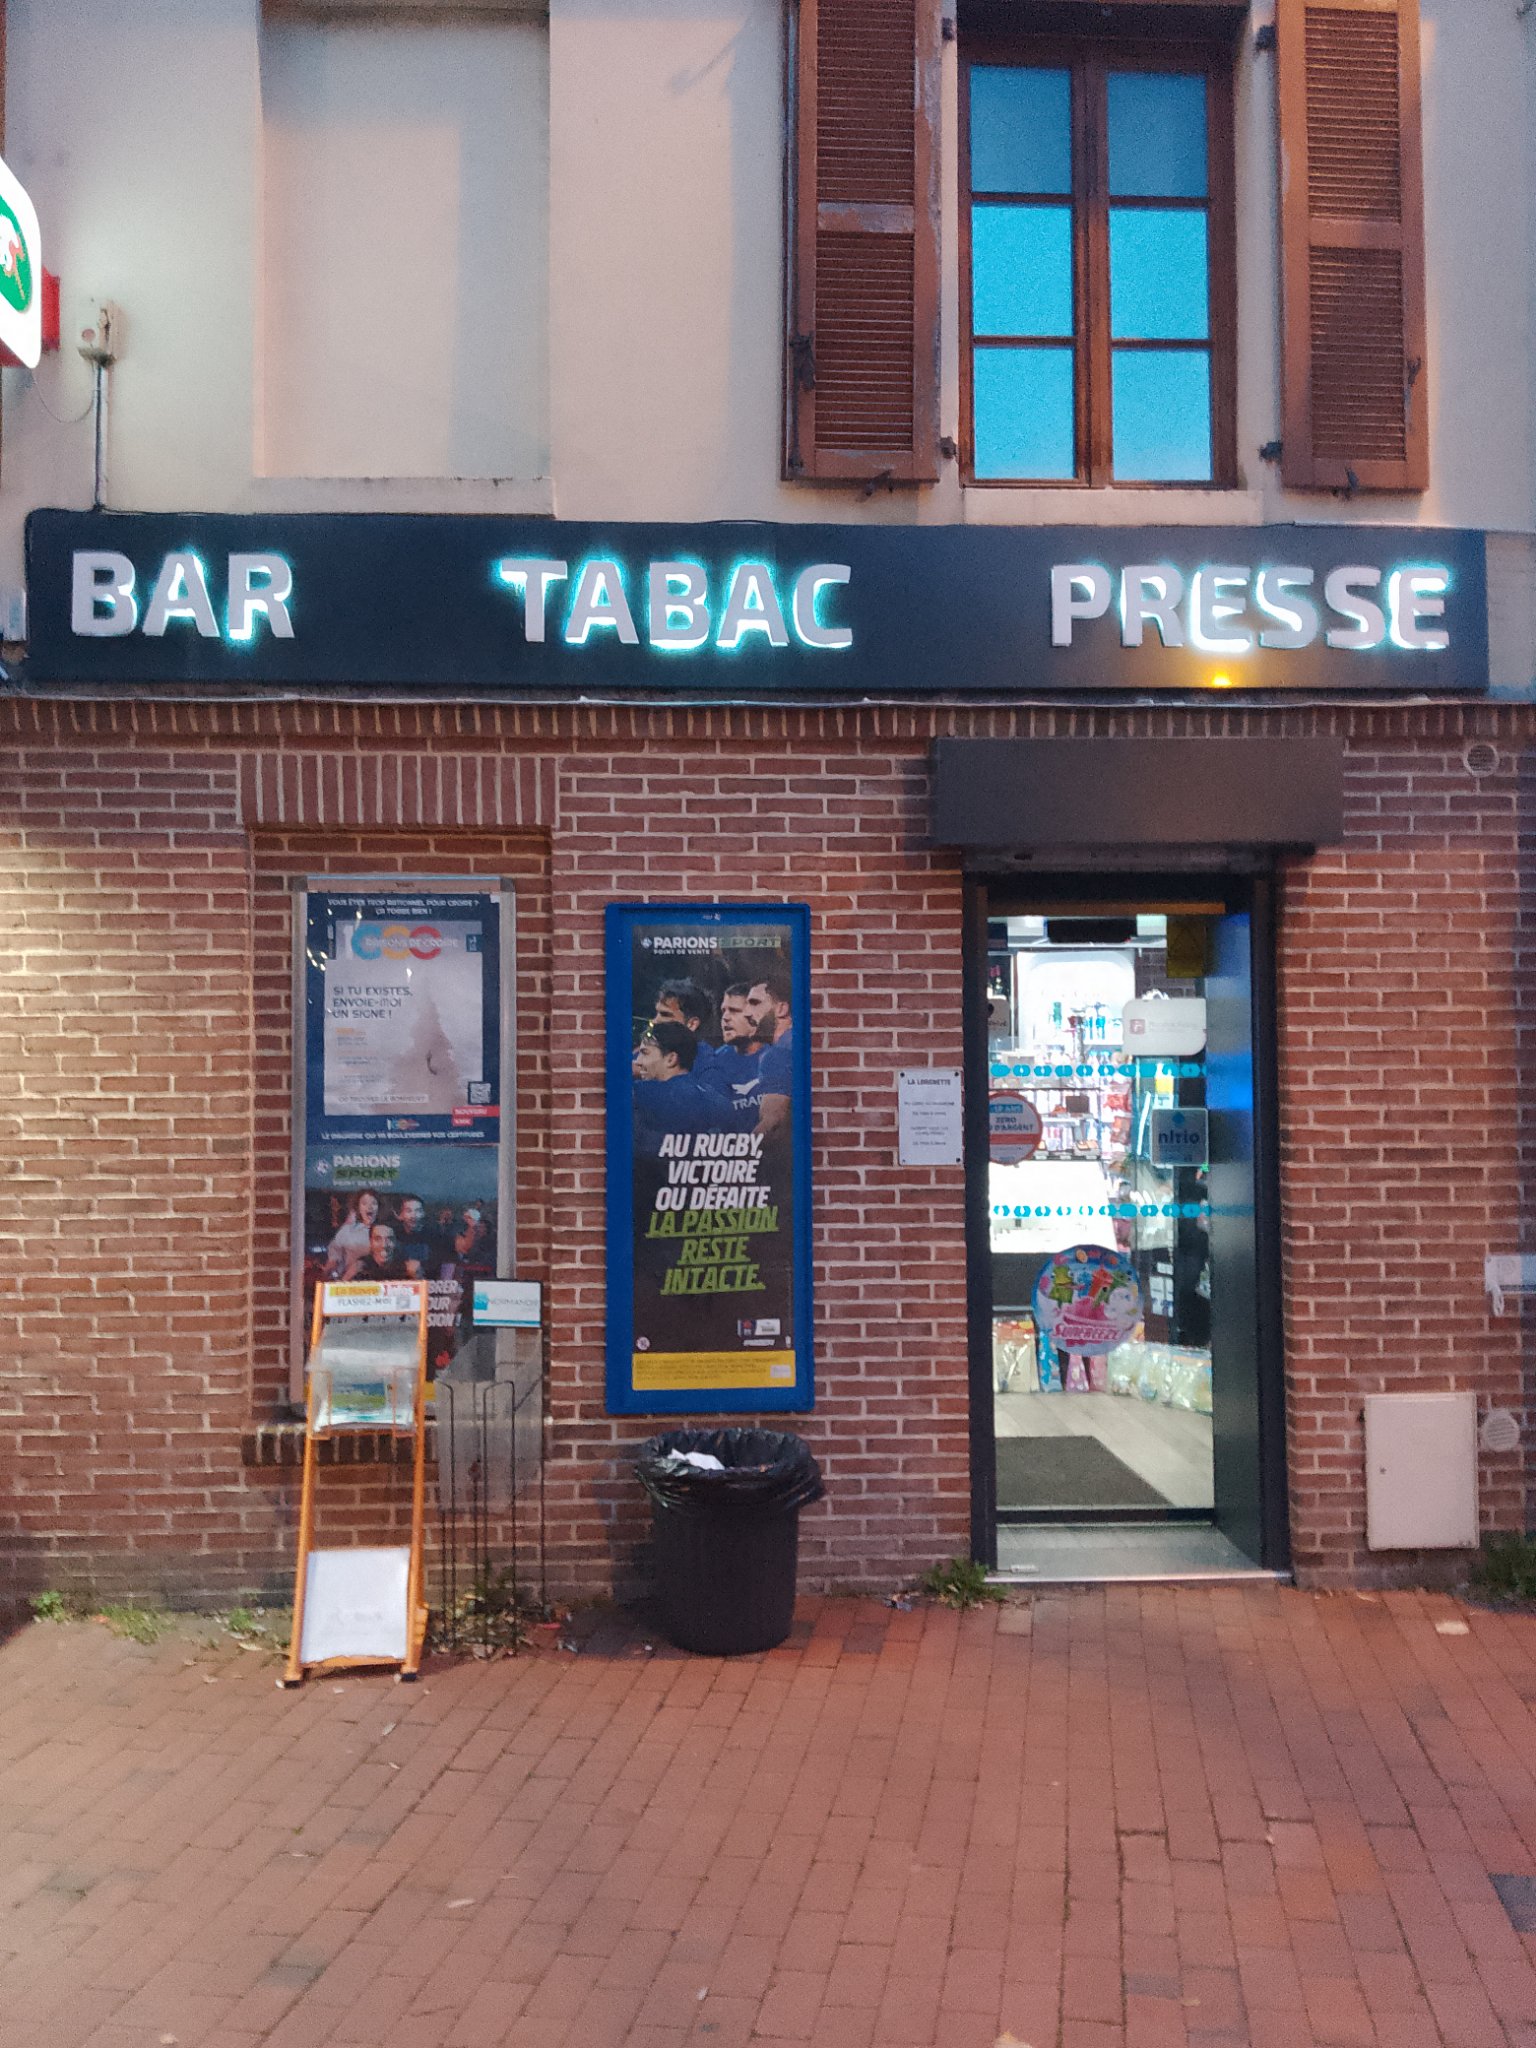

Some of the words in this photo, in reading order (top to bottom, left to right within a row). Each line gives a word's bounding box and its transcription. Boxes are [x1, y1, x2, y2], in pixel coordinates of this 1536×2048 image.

[71, 551, 296, 639] BAR
[500, 557, 854, 650] TABAC
[1050, 563, 1451, 650] PRESSE
[653, 936, 718, 949] PARIONS
[333, 986, 344, 996] SI
[347, 986, 362, 996] TU
[333, 997, 402, 1008] ENVOIE-MOI
[332, 1009, 349, 1019] UN
[352, 1009, 386, 1019] SIGNE
[907, 1078, 916, 1086] LA
[658, 1133, 691, 1158] AU
[693, 1132, 764, 1160] RUGBY,
[332, 1154, 401, 1168] PARIONS
[334, 1168, 400, 1180] SPORT
[667, 1158, 760, 1184] VICTOIRE
[655, 1186, 688, 1211] OU
[689, 1183, 771, 1211] DÉFAITE
[651, 1211, 674, 1236] LA
[683, 1205, 779, 1234] PASSION
[680, 1237, 751, 1264] RESTE
